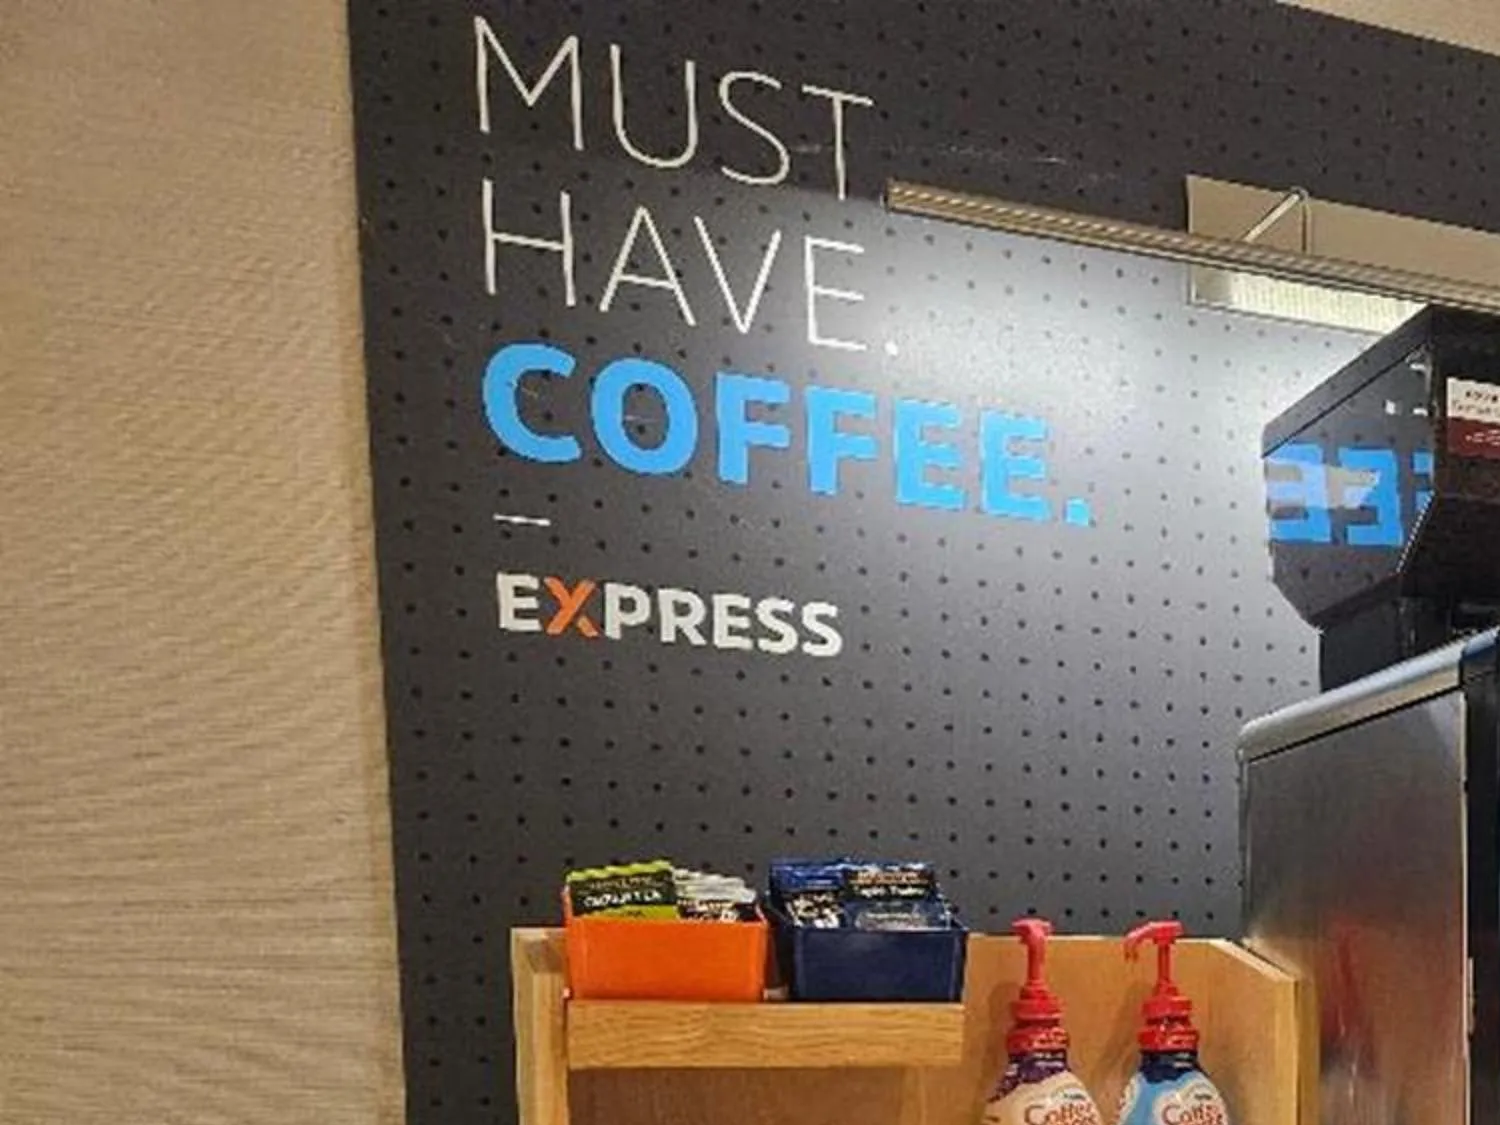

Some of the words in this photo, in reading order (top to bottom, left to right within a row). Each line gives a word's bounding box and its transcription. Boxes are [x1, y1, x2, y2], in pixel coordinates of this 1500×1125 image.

[474, 16, 873, 200] MUST
[482, 178, 899, 357] HAVE.
[481, 342, 1091, 526] COFFEE.
[496, 572, 844, 657] EXPRESS
